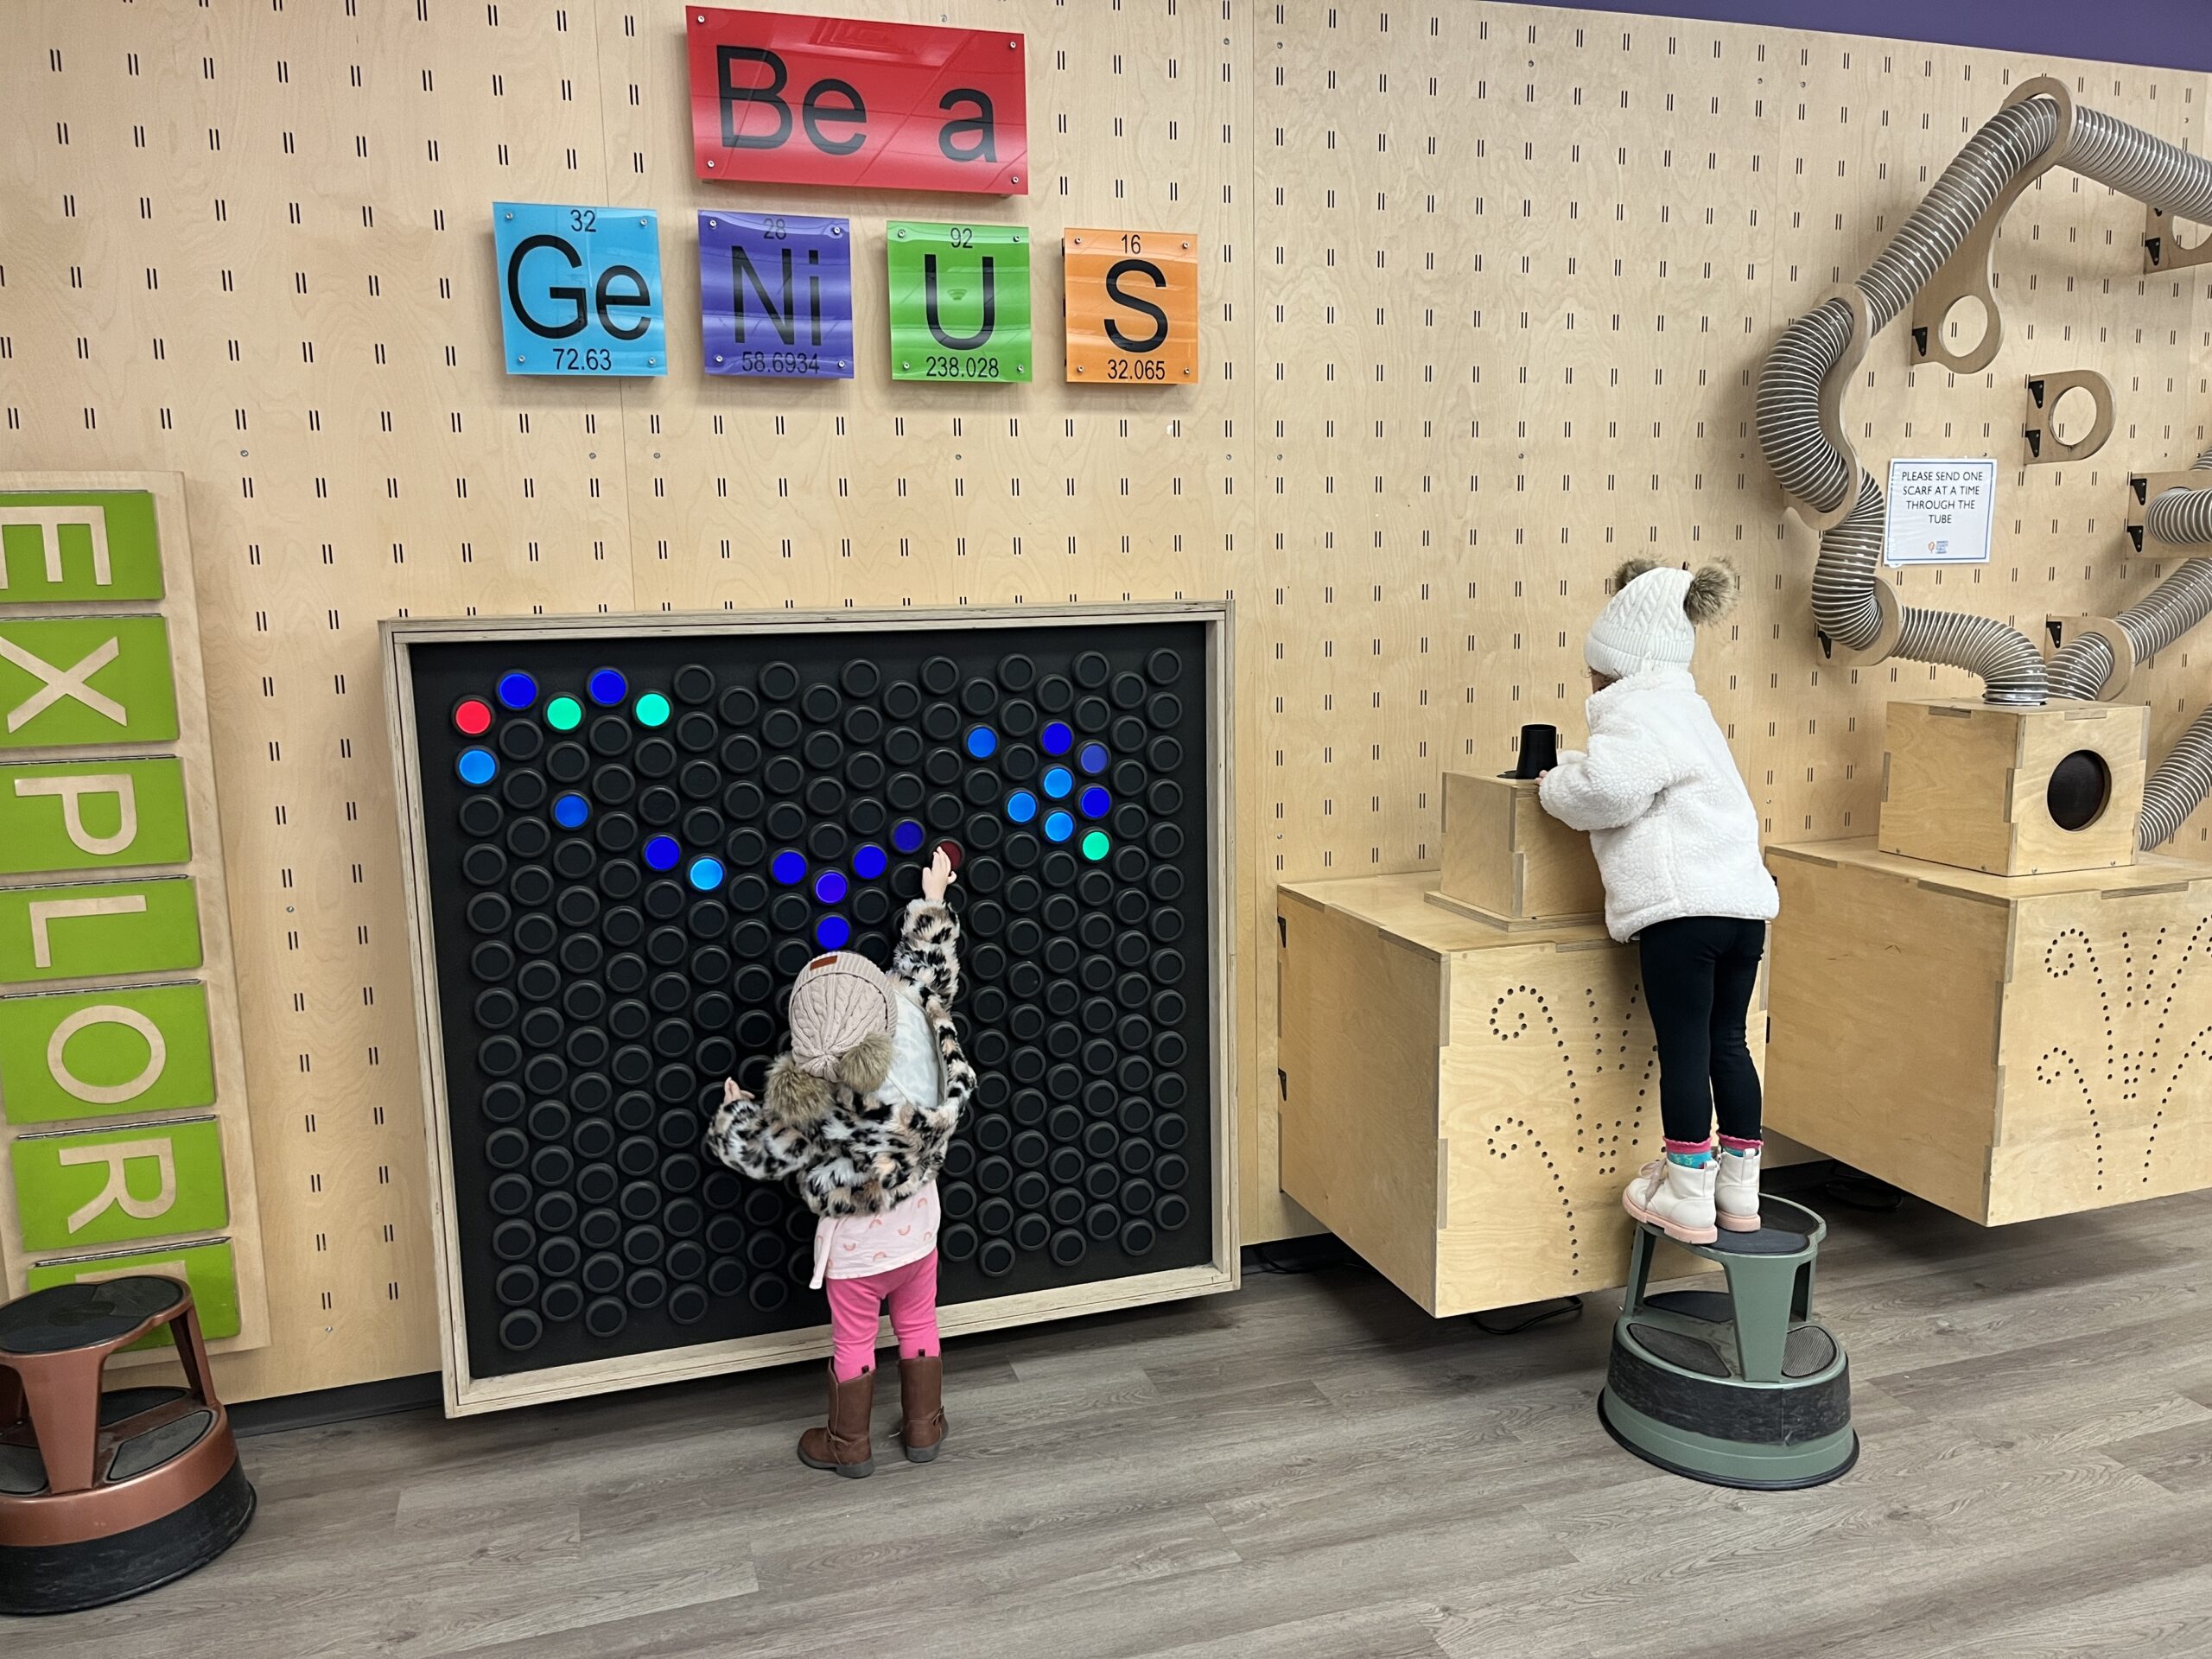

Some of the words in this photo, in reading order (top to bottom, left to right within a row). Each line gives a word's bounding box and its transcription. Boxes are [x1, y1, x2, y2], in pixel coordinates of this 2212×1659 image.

[716, 44, 868, 156] Be
[938, 88, 997, 162] a
[570, 209, 597, 232] 32
[763, 218, 787, 240] 28
[950, 227, 974, 249] 92
[1121, 234, 1141, 254] 16
[507, 234, 651, 340] Ge
[731, 245, 822, 346] Ni
[924, 254, 995, 350] U
[1103, 258, 1168, 353] S
[552, 348, 612, 371] 72.63
[741, 351, 820, 374] 58.6934
[925, 356, 1000, 378] 238.028
[1107, 359, 1166, 380] 32.065
[1902, 471, 1934, 481] PLEASE
[1936, 471, 1961, 481] SEND
[1962, 471, 1983, 481] ONE
[1903, 486, 1933, 495] SCARF
[1935, 486, 1948, 495] AT
[1949, 486, 1957, 495] A
[1960, 486, 1980, 495] TIME
[1906, 499, 1955, 510] THROUGH
[1958, 499, 1976, 510] THE
[1929, 514, 1953, 524] TUBE
[0, 505, 188, 1284] EXPLOR
